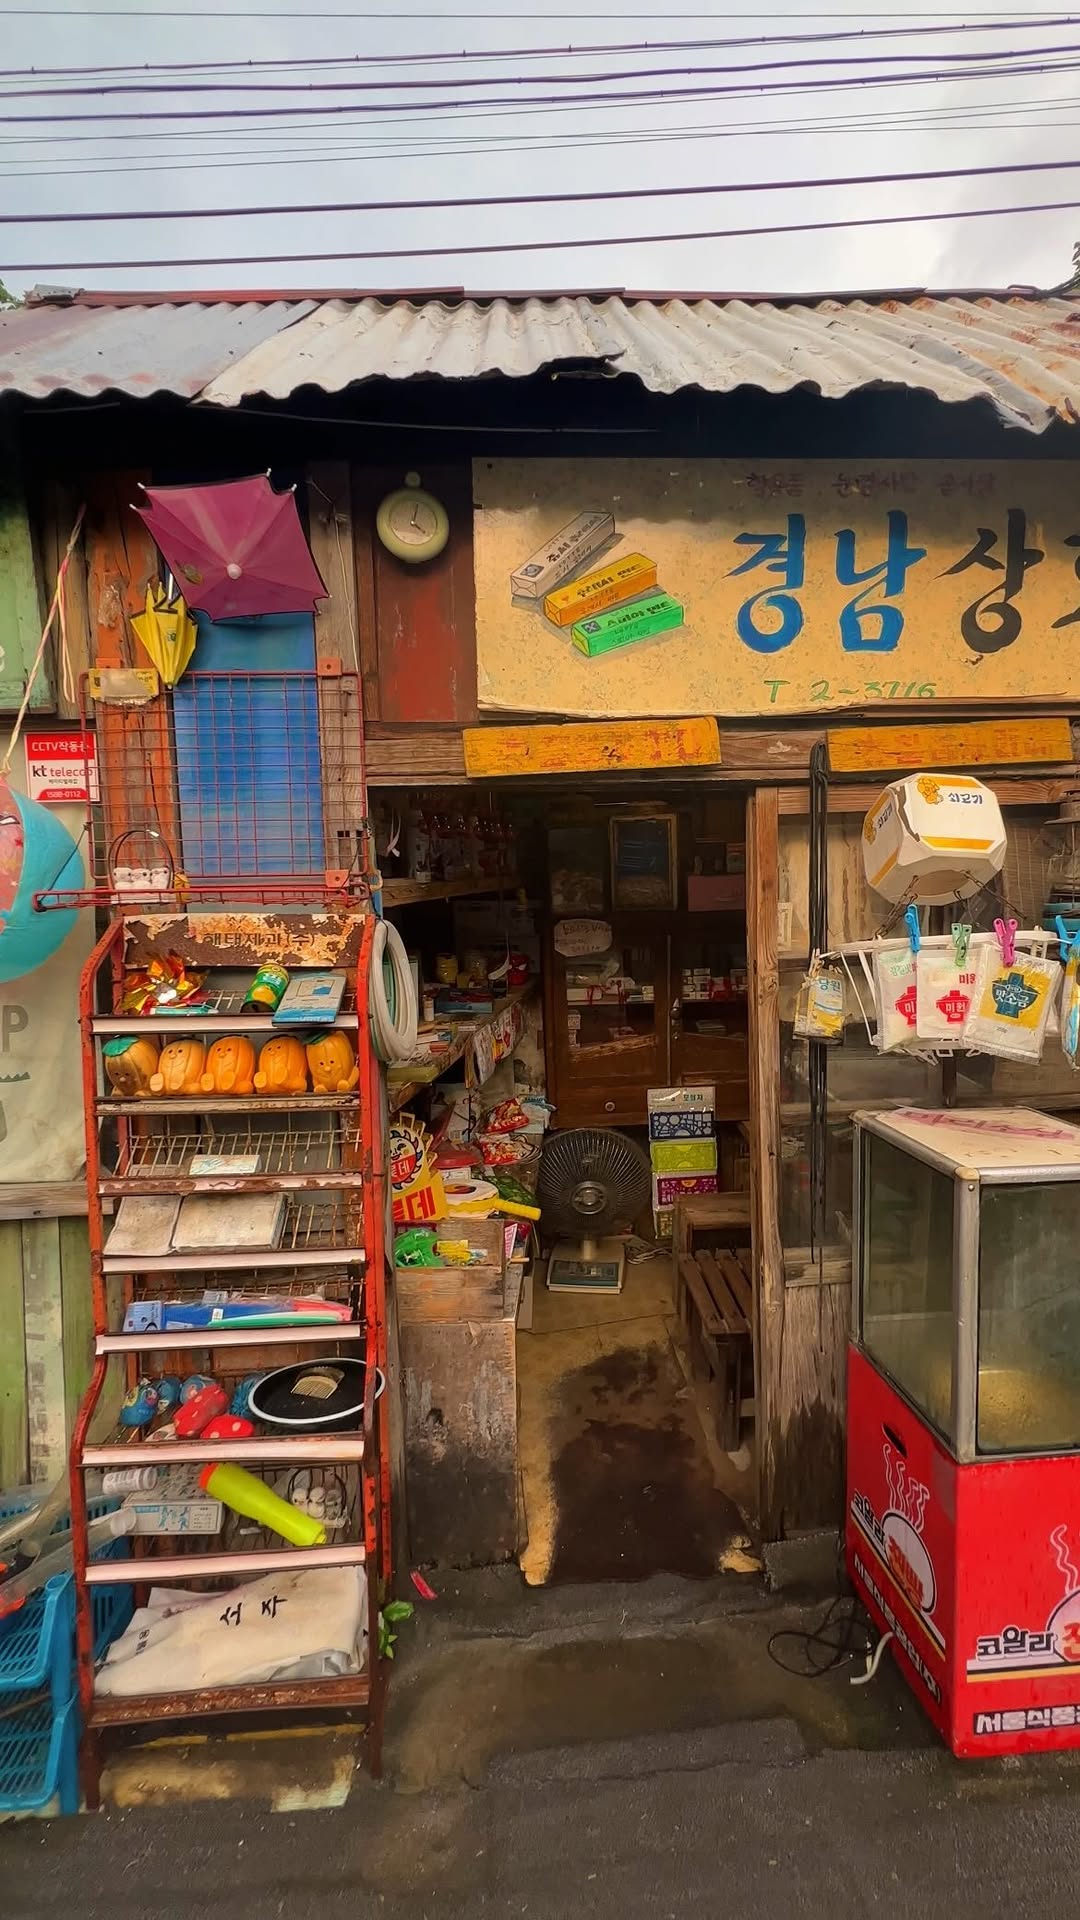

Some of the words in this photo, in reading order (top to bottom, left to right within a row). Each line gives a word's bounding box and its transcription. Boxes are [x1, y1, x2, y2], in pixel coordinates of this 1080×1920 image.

[764, 680, 791, 703] T
[32, 765, 47, 777] kt
[945, 1001, 966, 1013] 미원
[996, 988, 1029, 1008] 맛소금
[977, 1626, 1054, 1656] 코알라
[976, 1705, 1080, 1734] 서울식품
